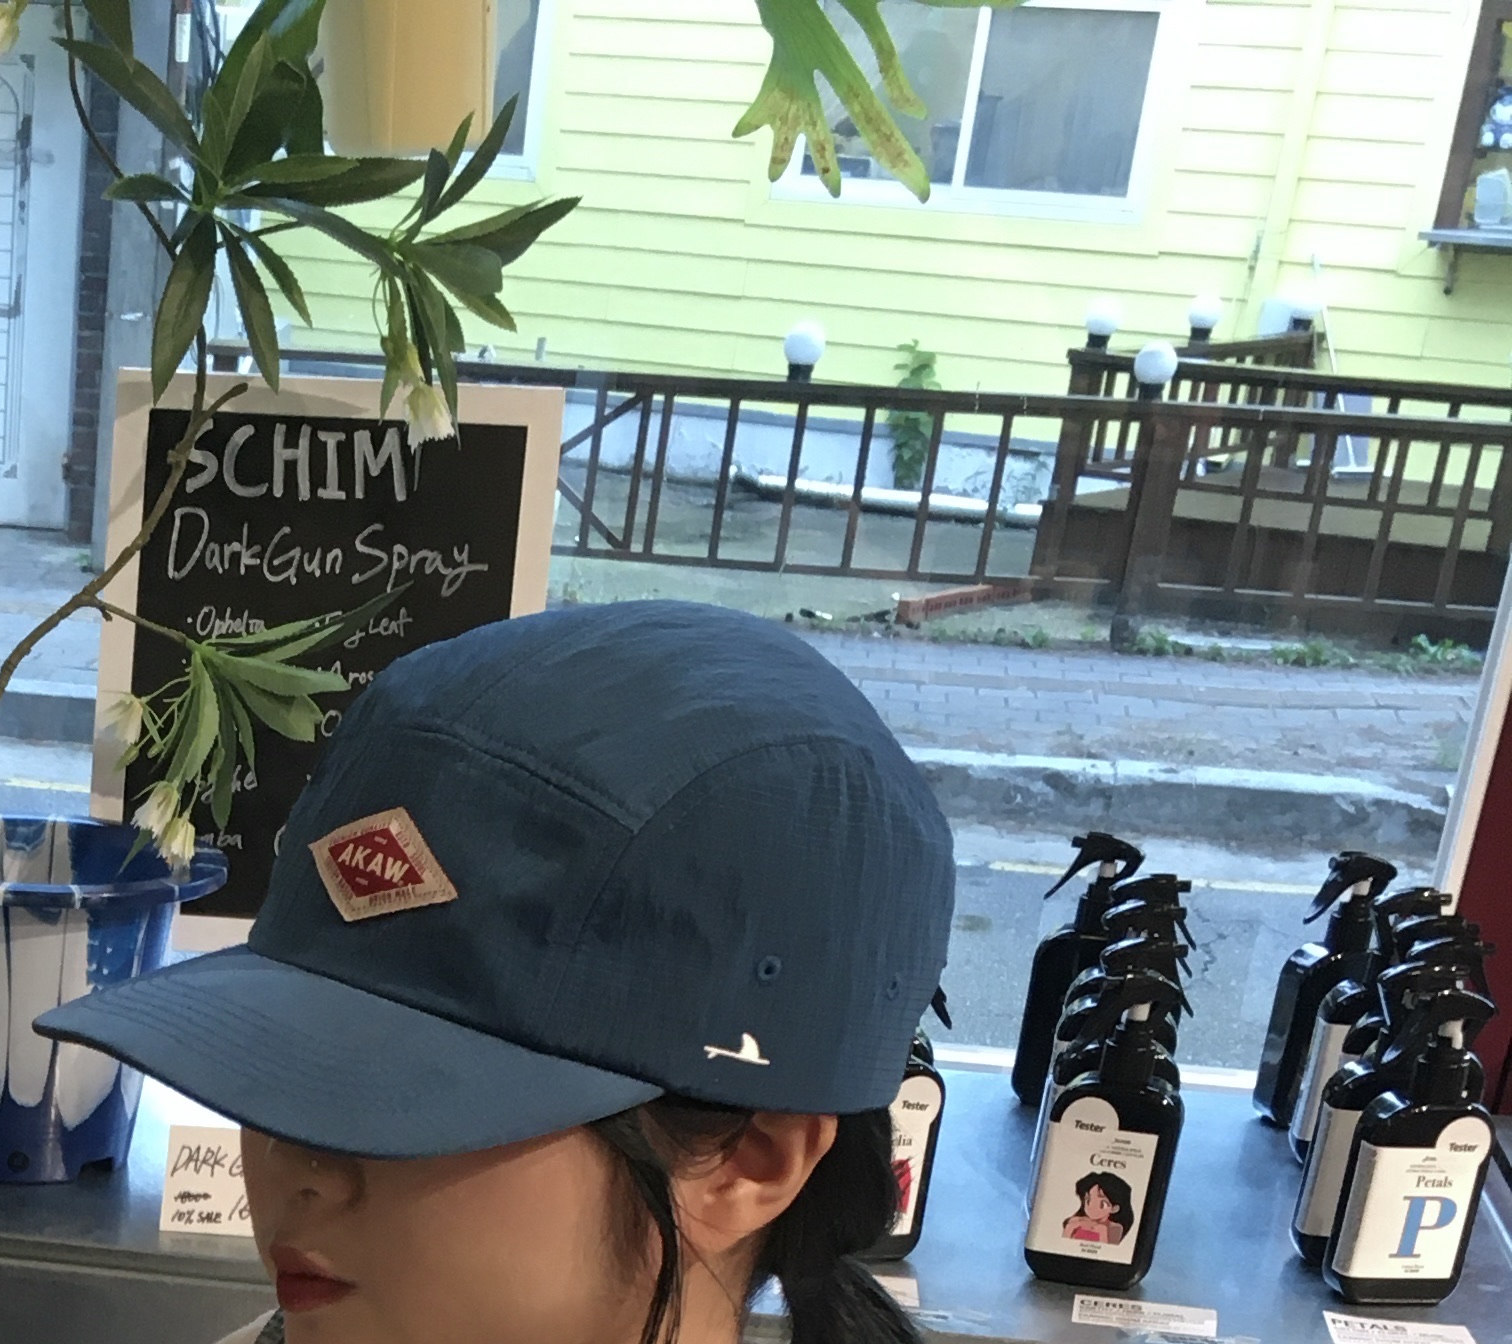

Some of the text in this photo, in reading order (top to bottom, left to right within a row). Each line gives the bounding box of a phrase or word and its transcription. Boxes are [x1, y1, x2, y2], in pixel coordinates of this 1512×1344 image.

[350, 523, 489, 597] Spray
[901, 1100, 929, 1111] Tester
[1074, 1119, 1106, 1133] Tester
[1449, 1142, 1477, 1152] Tester
[171, 1145, 228, 1177] DARK
[1089, 1153, 1127, 1170] Ceres
[1415, 1174, 1453, 1189] Petals
[1388, 1195, 1457, 1259] P
